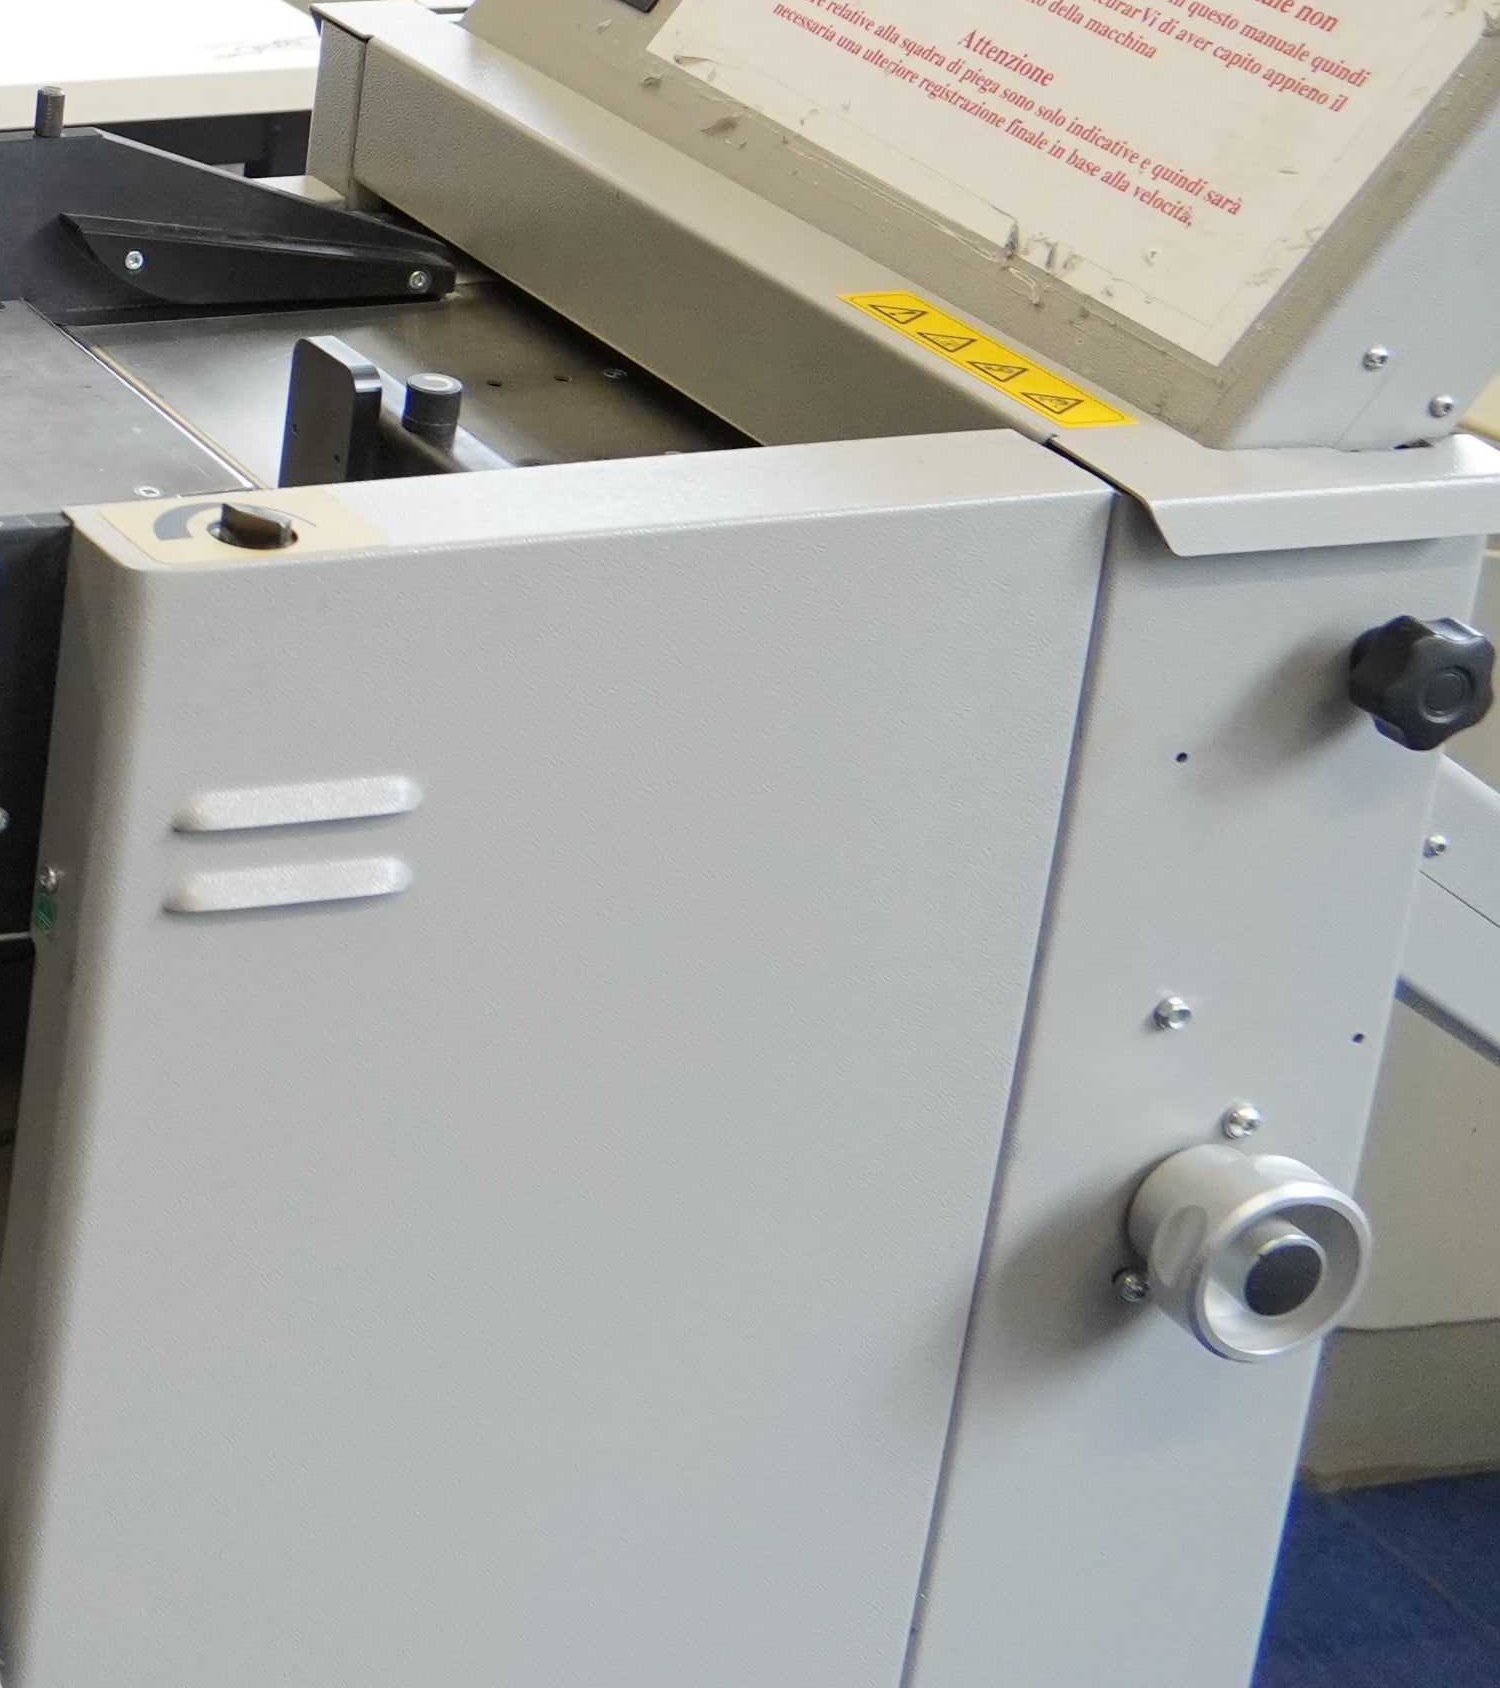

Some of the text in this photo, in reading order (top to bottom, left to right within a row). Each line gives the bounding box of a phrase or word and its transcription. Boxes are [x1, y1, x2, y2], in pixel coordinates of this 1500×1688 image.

[955, 28, 1055, 88] Attenzione
[1084, 18, 1157, 59] macchina
[1187, 1, 1239, 30] questo
[1239, 24, 1310, 62] manuale
[1310, 56, 1371, 88] quindi
[1294, 5, 1338, 32] non
[772, 3, 836, 42] necessaria
[836, 35, 862, 56] una
[862, 48, 920, 84] ulteriore
[918, 77, 1006, 128] registrazione
[1004, 118, 1048, 150] finale
[1047, 144, 1066, 159] in
[1066, 148, 1101, 177] base
[1100, 170, 1130, 193] alla
[825, 0, 876, 30] relative
[872, 25, 901, 44] alla
[901, 39, 947, 68] sqadra
[945, 58, 964, 76] di
[959, 68, 1002, 95] piega
[1000, 88, 1036, 111] sono
[1037, 106, 1067, 127] solo
[1066, 121, 1140, 162] indicative
[1139, 158, 1152, 168] e
[1151, 164, 1208, 197] quindi
[1205, 190, 1243, 215] sarà
[1158, 20, 1178, 35] di
[1176, 30, 1214, 51] aver
[1212, 46, 1264, 74] capito
[1261, 69, 1331, 104] appieno
[1329, 96, 1349, 112] il
